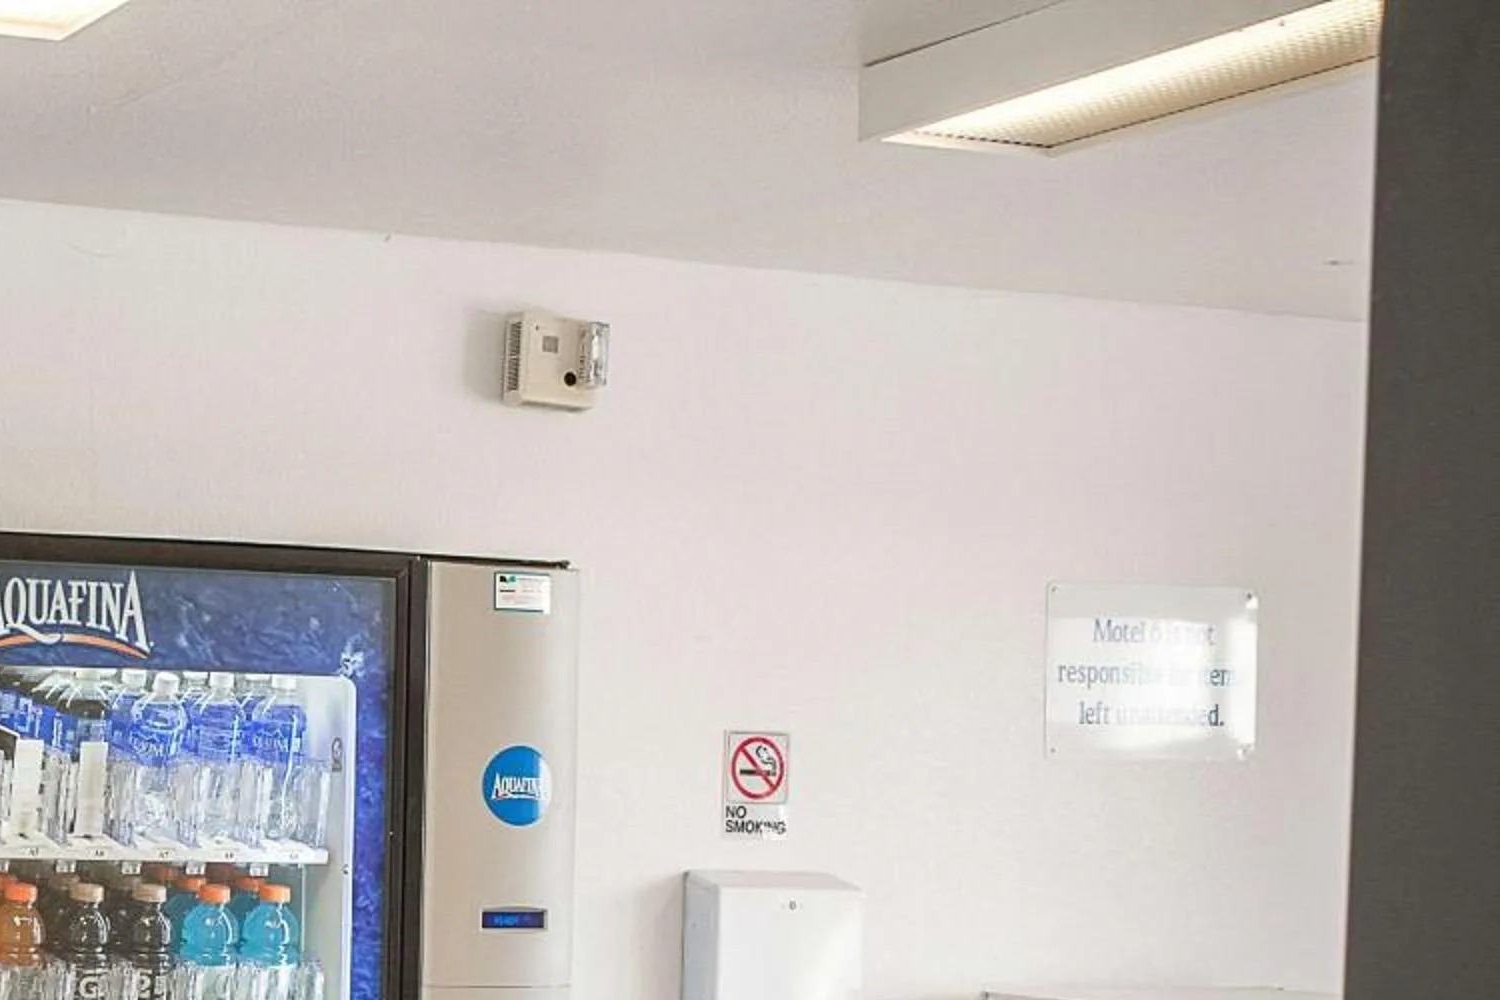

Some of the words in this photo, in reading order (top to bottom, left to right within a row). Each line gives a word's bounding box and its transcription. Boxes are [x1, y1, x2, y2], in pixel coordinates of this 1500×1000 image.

[1093, 618, 1146, 643] Motel
[1078, 701, 1110, 725] left
[725, 805, 747, 819] NO
